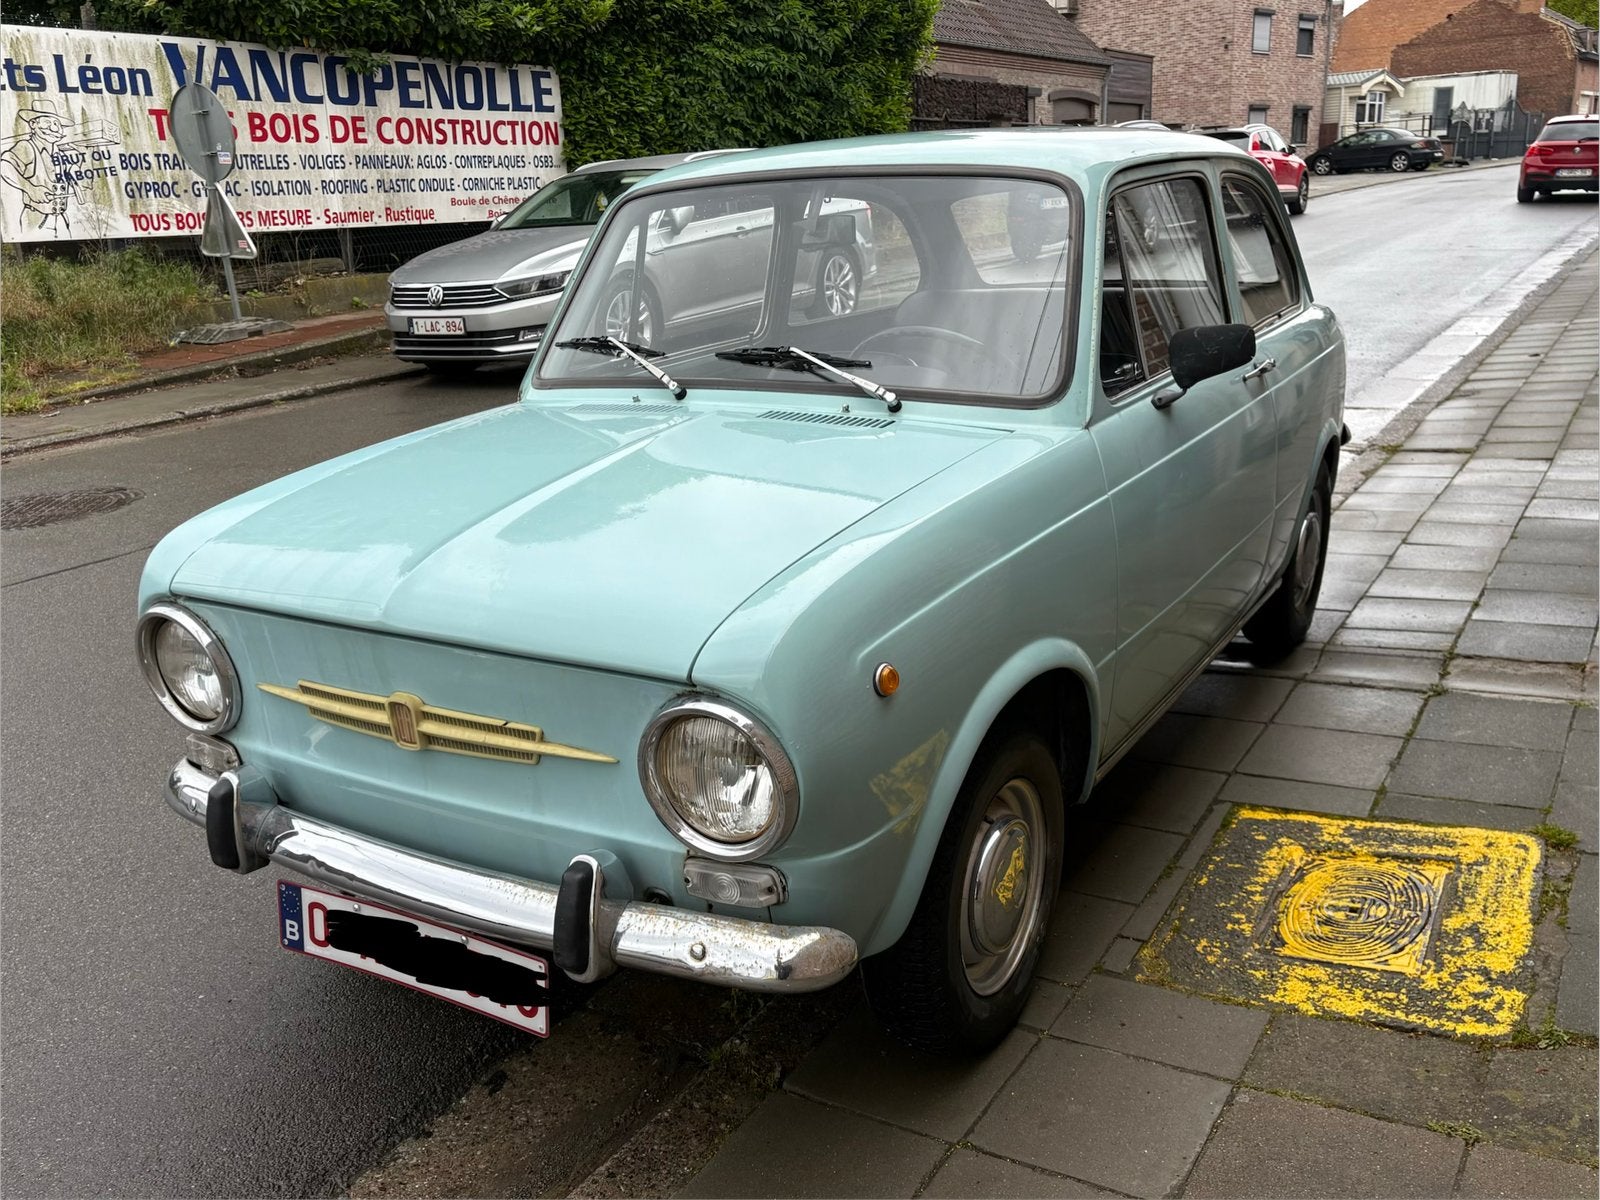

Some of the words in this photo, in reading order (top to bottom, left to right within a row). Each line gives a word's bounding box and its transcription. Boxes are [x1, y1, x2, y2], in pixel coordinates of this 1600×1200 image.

[0, 58, 47, 92] ts
[53, 53, 153, 97] Léon
[161, 42, 555, 112] VANCOPENOLLE
[248, 112, 319, 143] BOIS
[330, 116, 367, 144] DE
[376, 117, 559, 145] CONSTRUCTION
[51, 153, 86, 167] BRUT
[92, 150, 111, 161] OU
[119, 153, 152, 171] BOIS
[154, 153, 192, 171] TRAI
[231, 154, 289, 171] UTRELLES
[299, 154, 346, 170] VOLIGES
[355, 154, 414, 169] PANNEAUX:
[417, 155, 447, 169] AGLOS
[454, 155, 526, 171] CONTREPLAQUES
[55, 166, 118, 184] RABOTTE
[124, 181, 181, 199] GYPROC
[191, 181, 241, 198] GYAC
[252, 180, 312, 196] ISOLATION
[321, 180, 368, 195] ROOFING
[376, 179, 416, 193] PLASTIC
[418, 178, 455, 192] ONDULE
[462, 177, 505, 191] CORNICHE
[507, 176, 541, 190] PLASTIC
[450, 197, 477, 206] Boule
[478, 196, 490, 205] de
[492, 195, 520, 205] Chêne
[130, 213, 171, 232] TOUS
[257, 209, 313, 227] MESURE
[324, 208, 375, 224] Saumier
[385, 206, 435, 224] Rustique
[285, 919, 299, 941] B
